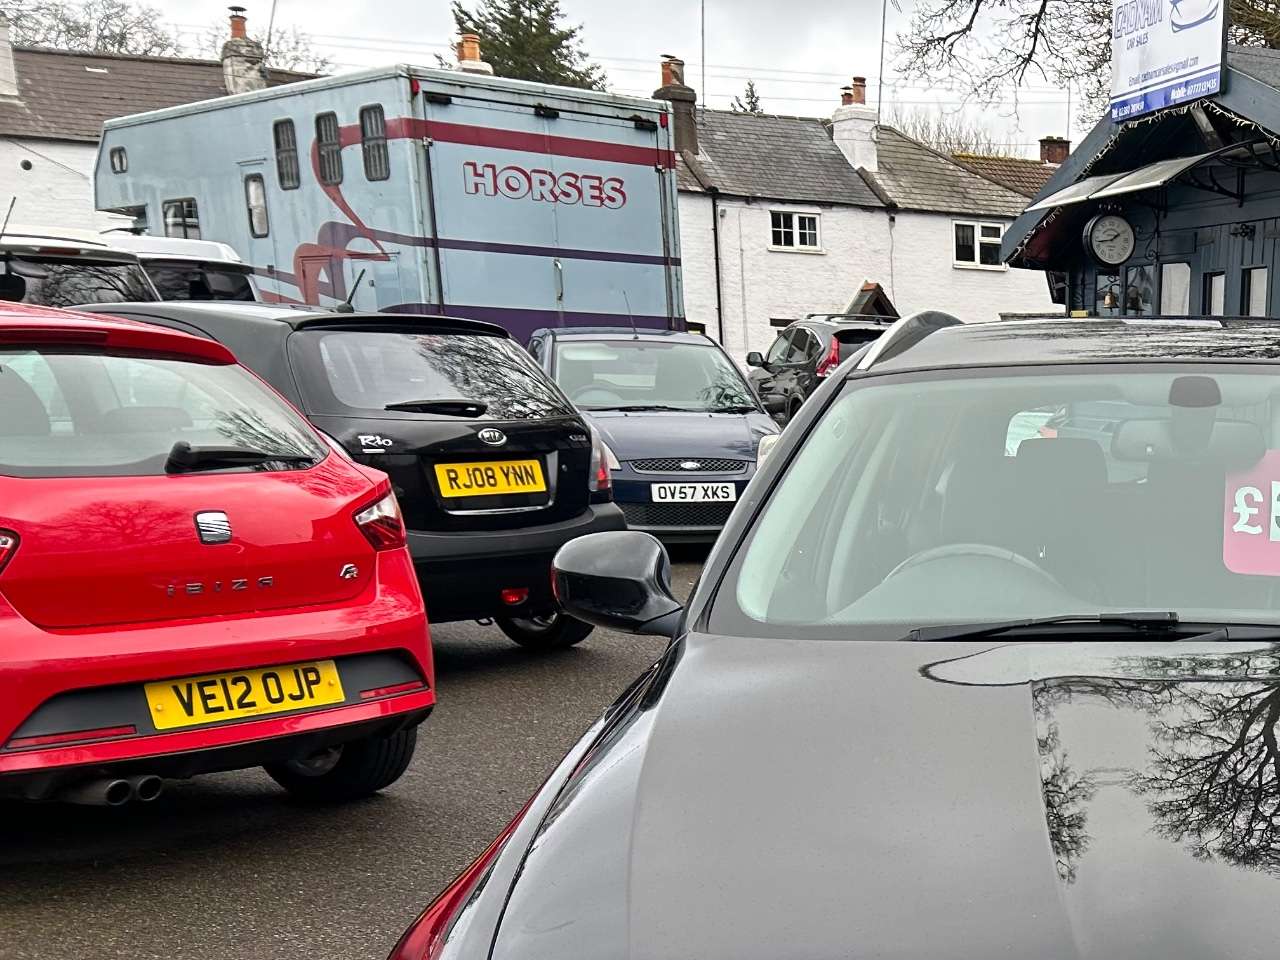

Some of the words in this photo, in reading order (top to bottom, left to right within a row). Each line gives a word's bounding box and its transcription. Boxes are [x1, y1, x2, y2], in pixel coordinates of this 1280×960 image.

[463, 162, 627, 209] HORSES
[446, 467, 498, 489] RJ08
[500, 465, 537, 486] YNN
[658, 486, 697, 500] OV57
[702, 486, 730, 500] XKS
[167, 576, 273, 596] IBIZA
[172, 675, 256, 717] VE12
[261, 667, 321, 704] OJP
